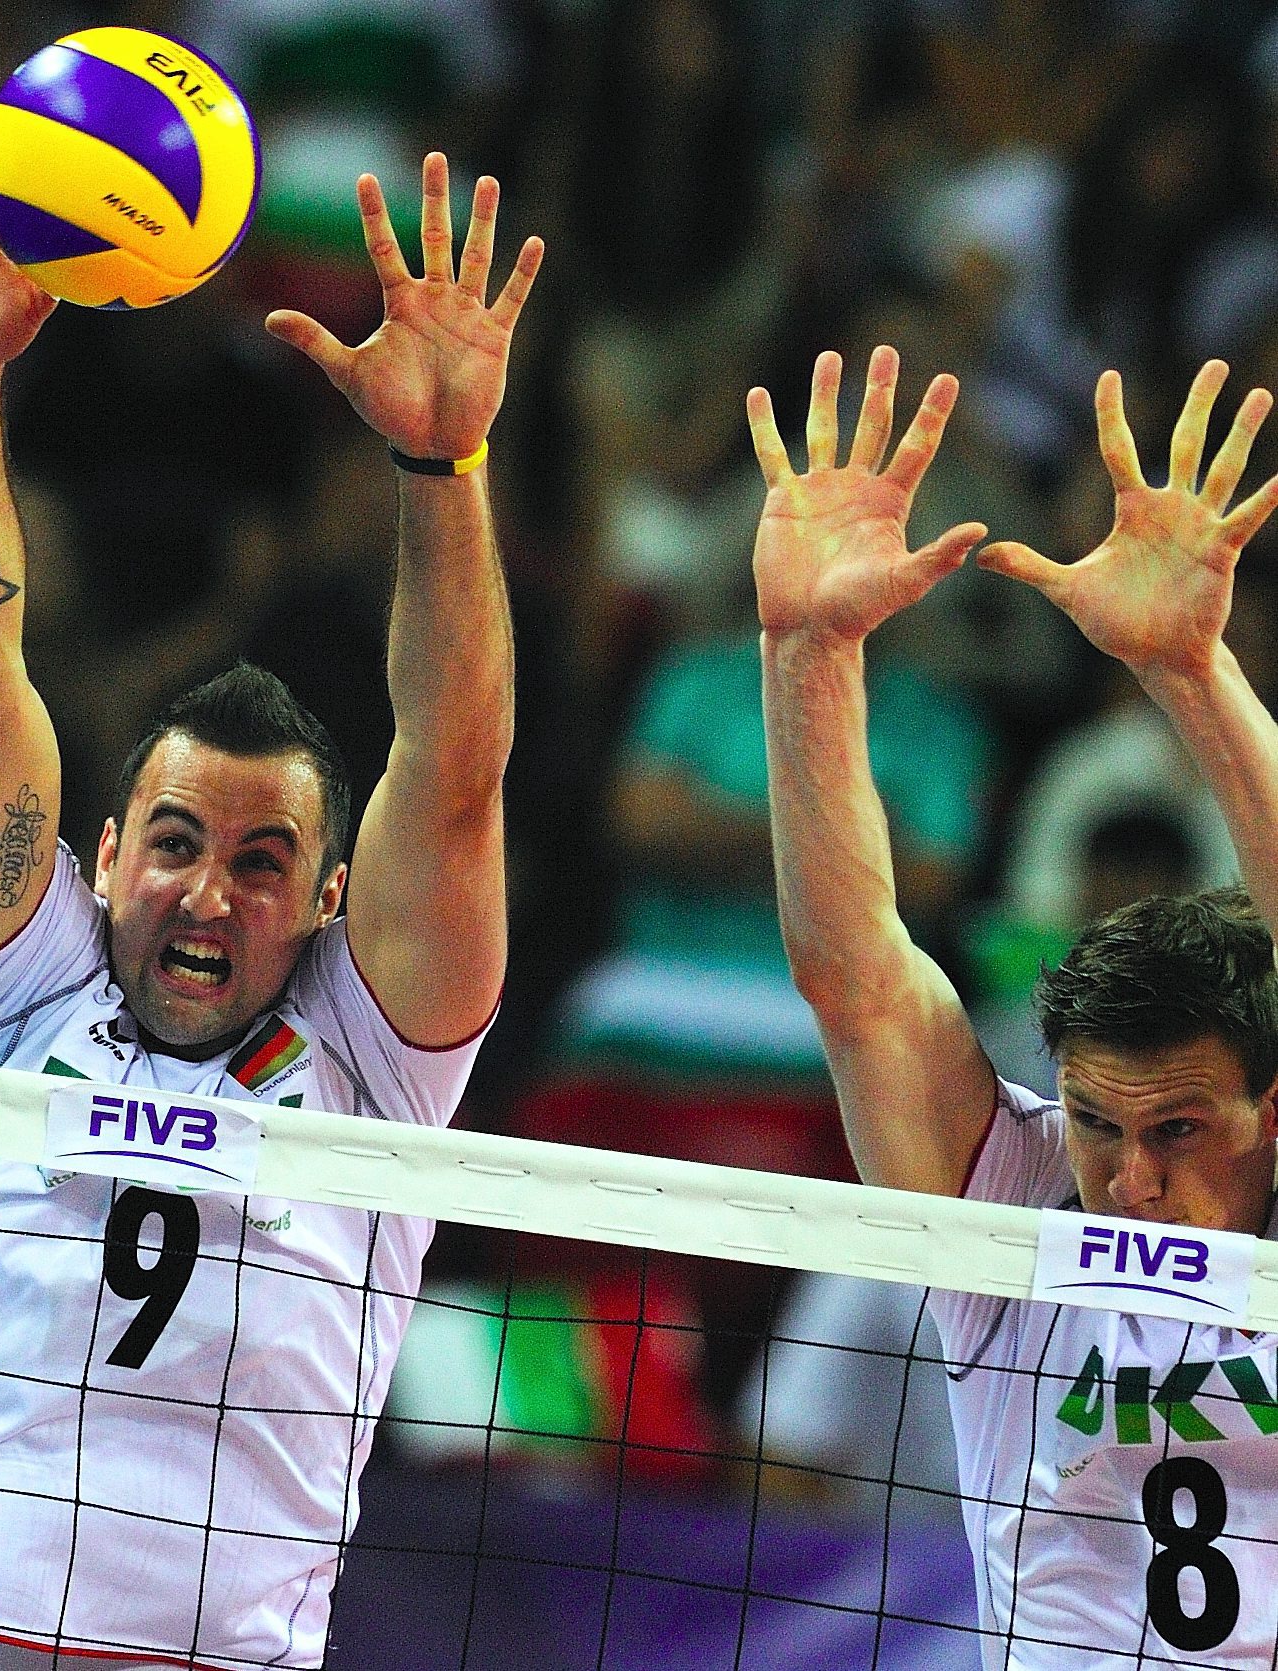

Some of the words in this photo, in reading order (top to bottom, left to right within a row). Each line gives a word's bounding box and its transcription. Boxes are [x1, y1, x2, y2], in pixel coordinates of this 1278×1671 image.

[146, 52, 216, 116] FIVB
[102, 193, 165, 236] MVA200
[253, 1057, 313, 1098] Deutschlan
[88, 1095, 218, 1152] FIVB
[103, 1185, 201, 1370] 9
[1079, 1225, 1210, 1282] FIVB
[1141, 1455, 1241, 1652] 8
